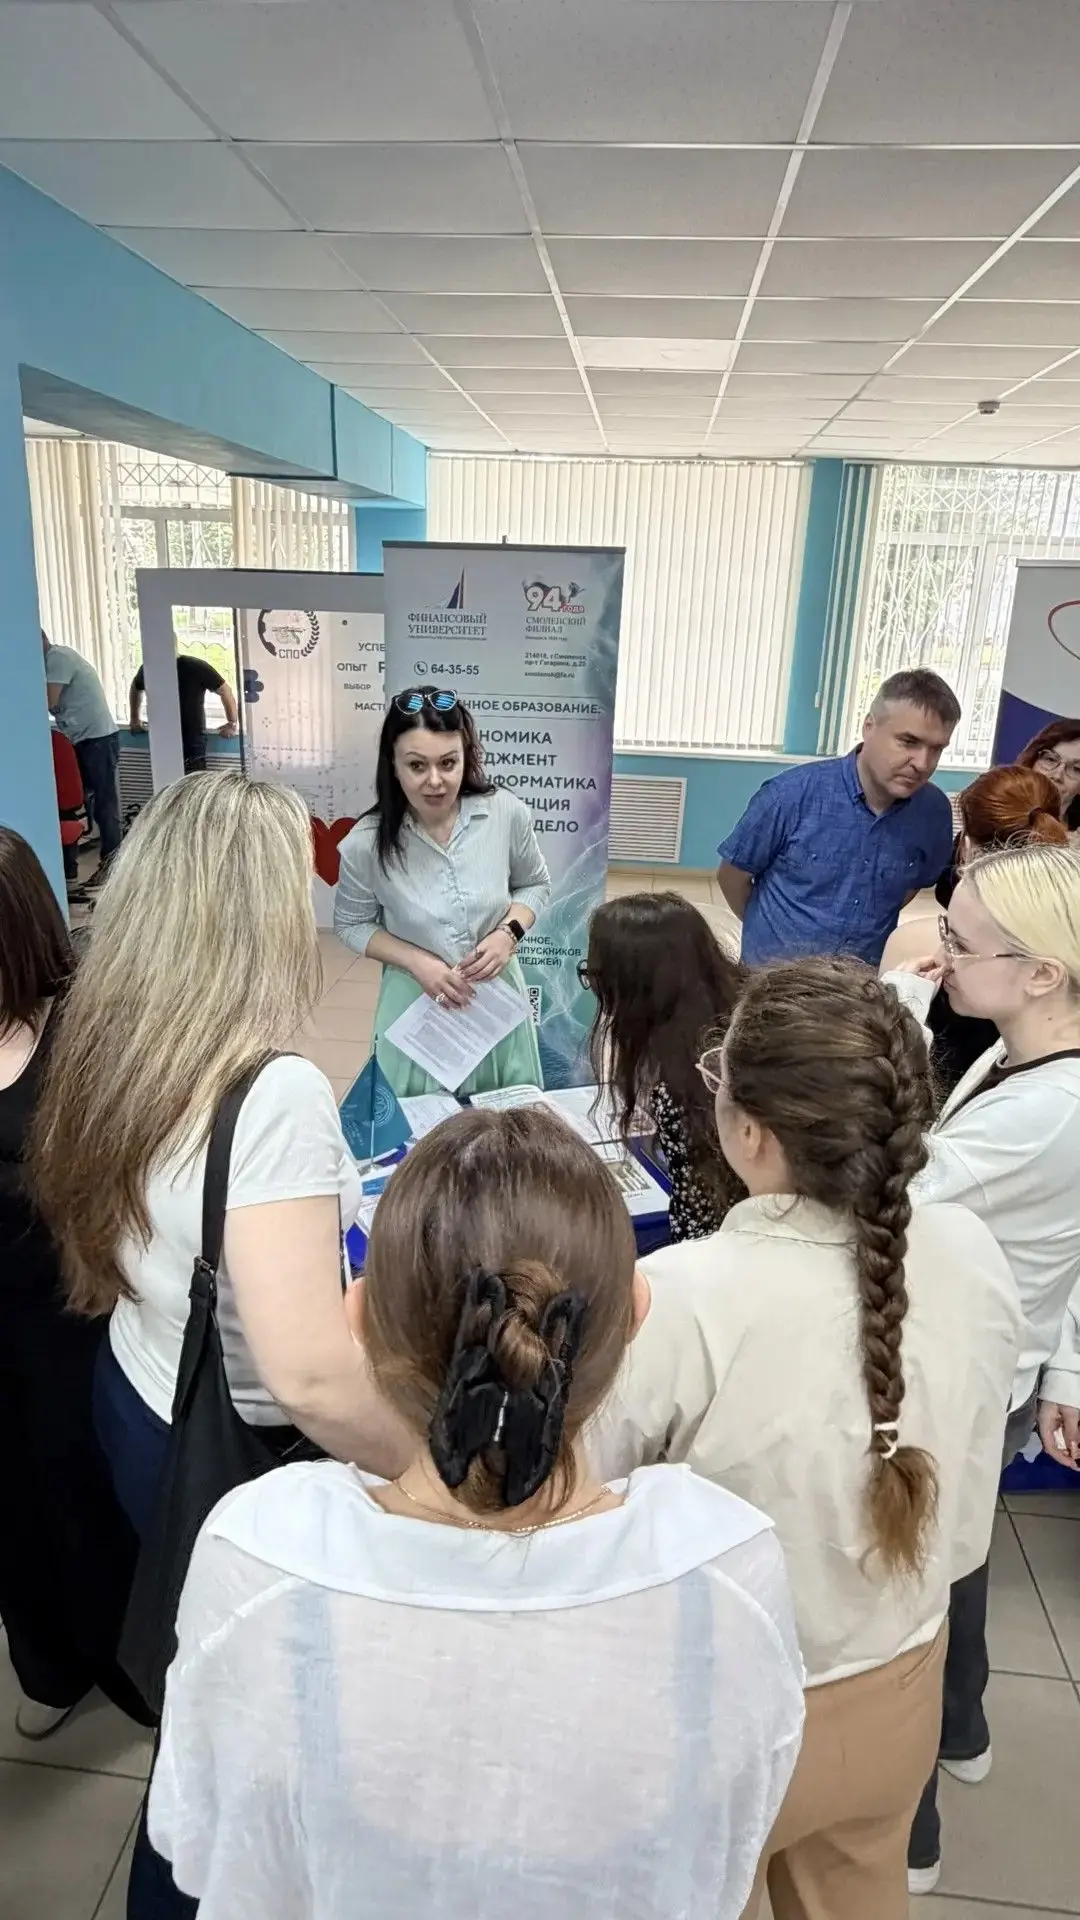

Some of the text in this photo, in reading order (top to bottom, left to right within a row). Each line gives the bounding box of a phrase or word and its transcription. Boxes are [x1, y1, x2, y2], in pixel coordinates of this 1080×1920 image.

[526, 585, 561, 612] 94
[407, 612, 487, 624] ФИНАНСОВЫЙ
[407, 624, 487, 636] УНИВЕРСИТЕТ
[278, 648, 300, 659] СПО
[336, 663, 367, 672] ОПЫТ
[430, 664, 480, 675] 64-35-55
[354, 702, 386, 711] МАСТ
[479, 729, 553, 745] НОМИКА
[518, 797, 571, 812] НЦИЯ
[533, 819, 579, 833] ДЕЛО
[520, 936, 554, 946] ЧНОЕ,
